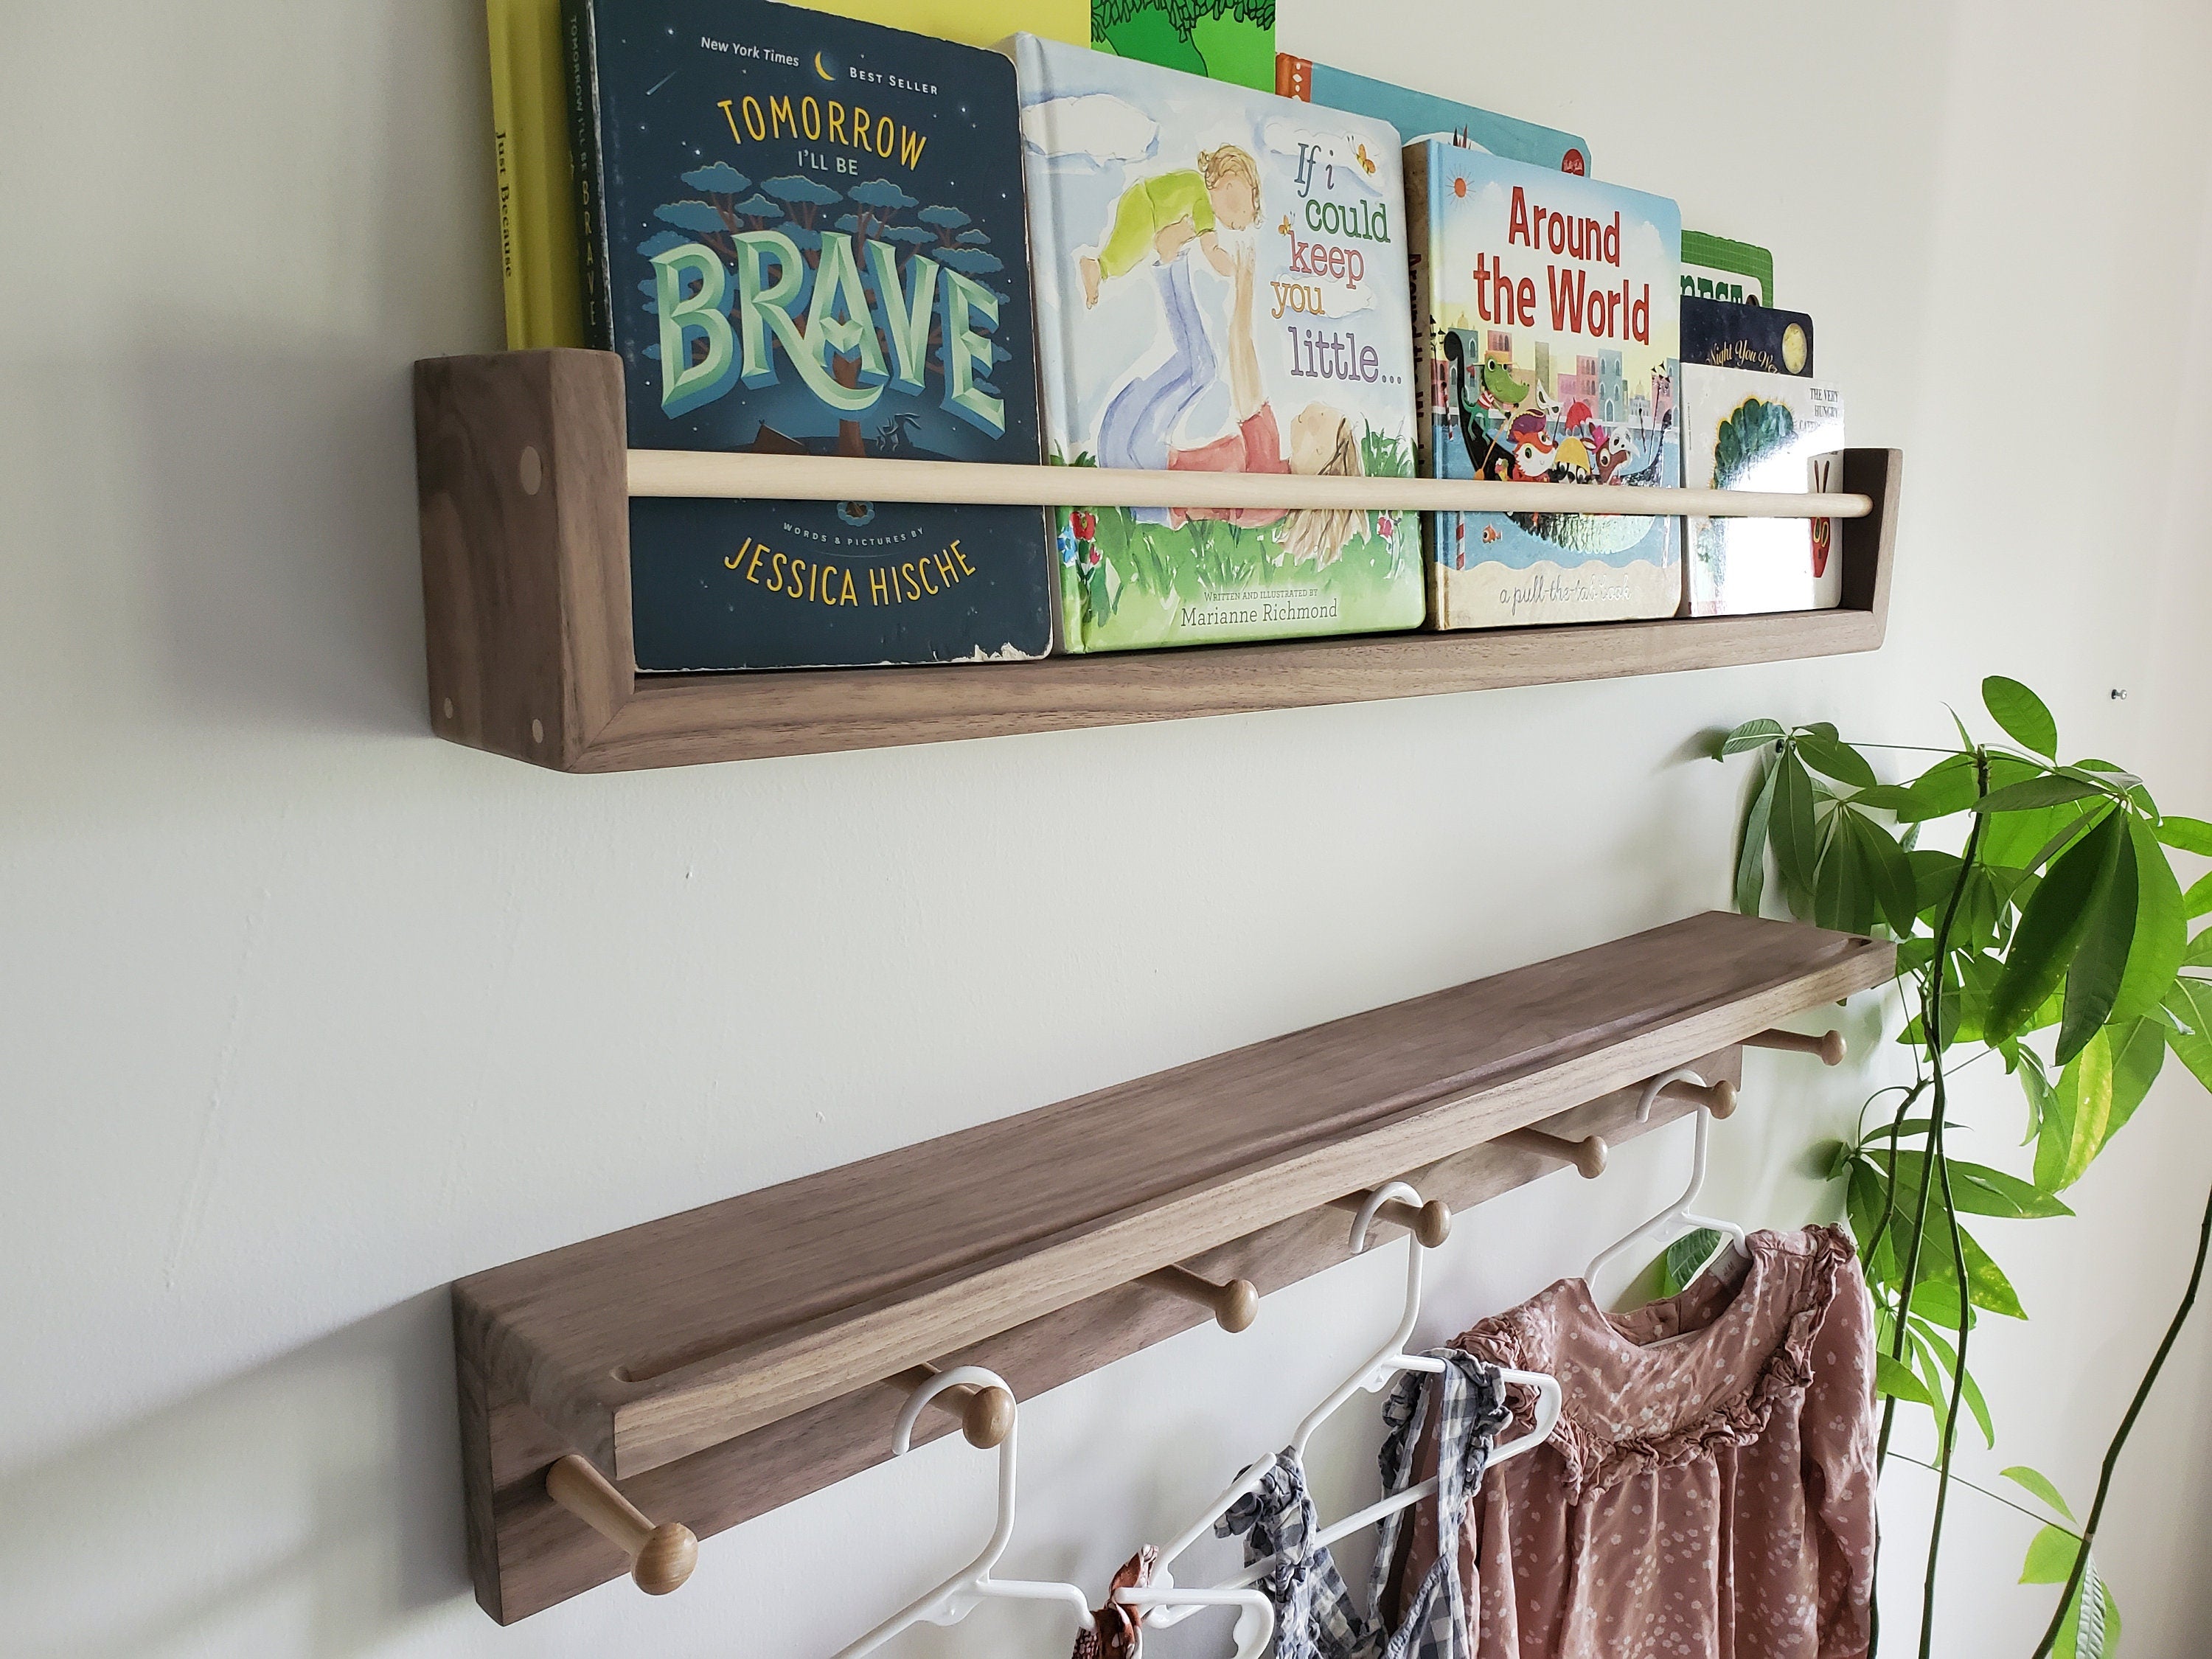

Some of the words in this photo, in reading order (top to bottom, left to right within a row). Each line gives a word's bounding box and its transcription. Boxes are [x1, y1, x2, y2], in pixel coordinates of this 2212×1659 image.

[700, 36, 729, 53] New
[732, 43, 760, 60] York
[762, 49, 800, 67] Times
[849, 66, 883, 84] BEST
[888, 74, 939, 96] SELLER
[495, 131, 507, 175] Just
[717, 94, 928, 171] TOMORROW
[570, 15, 583, 112] TOMORROW
[582, 180, 596, 326] BRAVE
[797, 149, 830, 171] I'LL
[835, 156, 860, 176] BE
[1294, 142, 1322, 198] If
[1325, 149, 1335, 190] i
[500, 185, 512, 278] Because
[1305, 198, 1391, 243] could
[1508, 186, 1620, 268] Around
[1288, 229, 1364, 290] keep
[1270, 281, 1326, 319] you
[1473, 251, 1537, 327] the
[1546, 264, 1649, 346] World
[649, 229, 1006, 437] BRAVE
[1705, 341, 1733, 367] Night
[1734, 339, 1757, 366] You
[1809, 388, 1823, 401] THE
[1823, 389, 1839, 403] VERY
[783, 522, 827, 543] WORDS
[834, 536, 841, 546] &
[847, 533, 907, 547] PICTURES
[911, 526, 925, 538] BY
[724, 536, 859, 608] JESSICA
[869, 539, 977, 607] HISCHE
[1242, 590, 1259, 600] AND
[1259, 588, 1308, 599] ILLUSTRATED
[1308, 588, 1318, 597] BY
[1499, 588, 1511, 604] a
[1180, 606, 1257, 627] Marianne
[1262, 598, 1338, 622] Richmond
